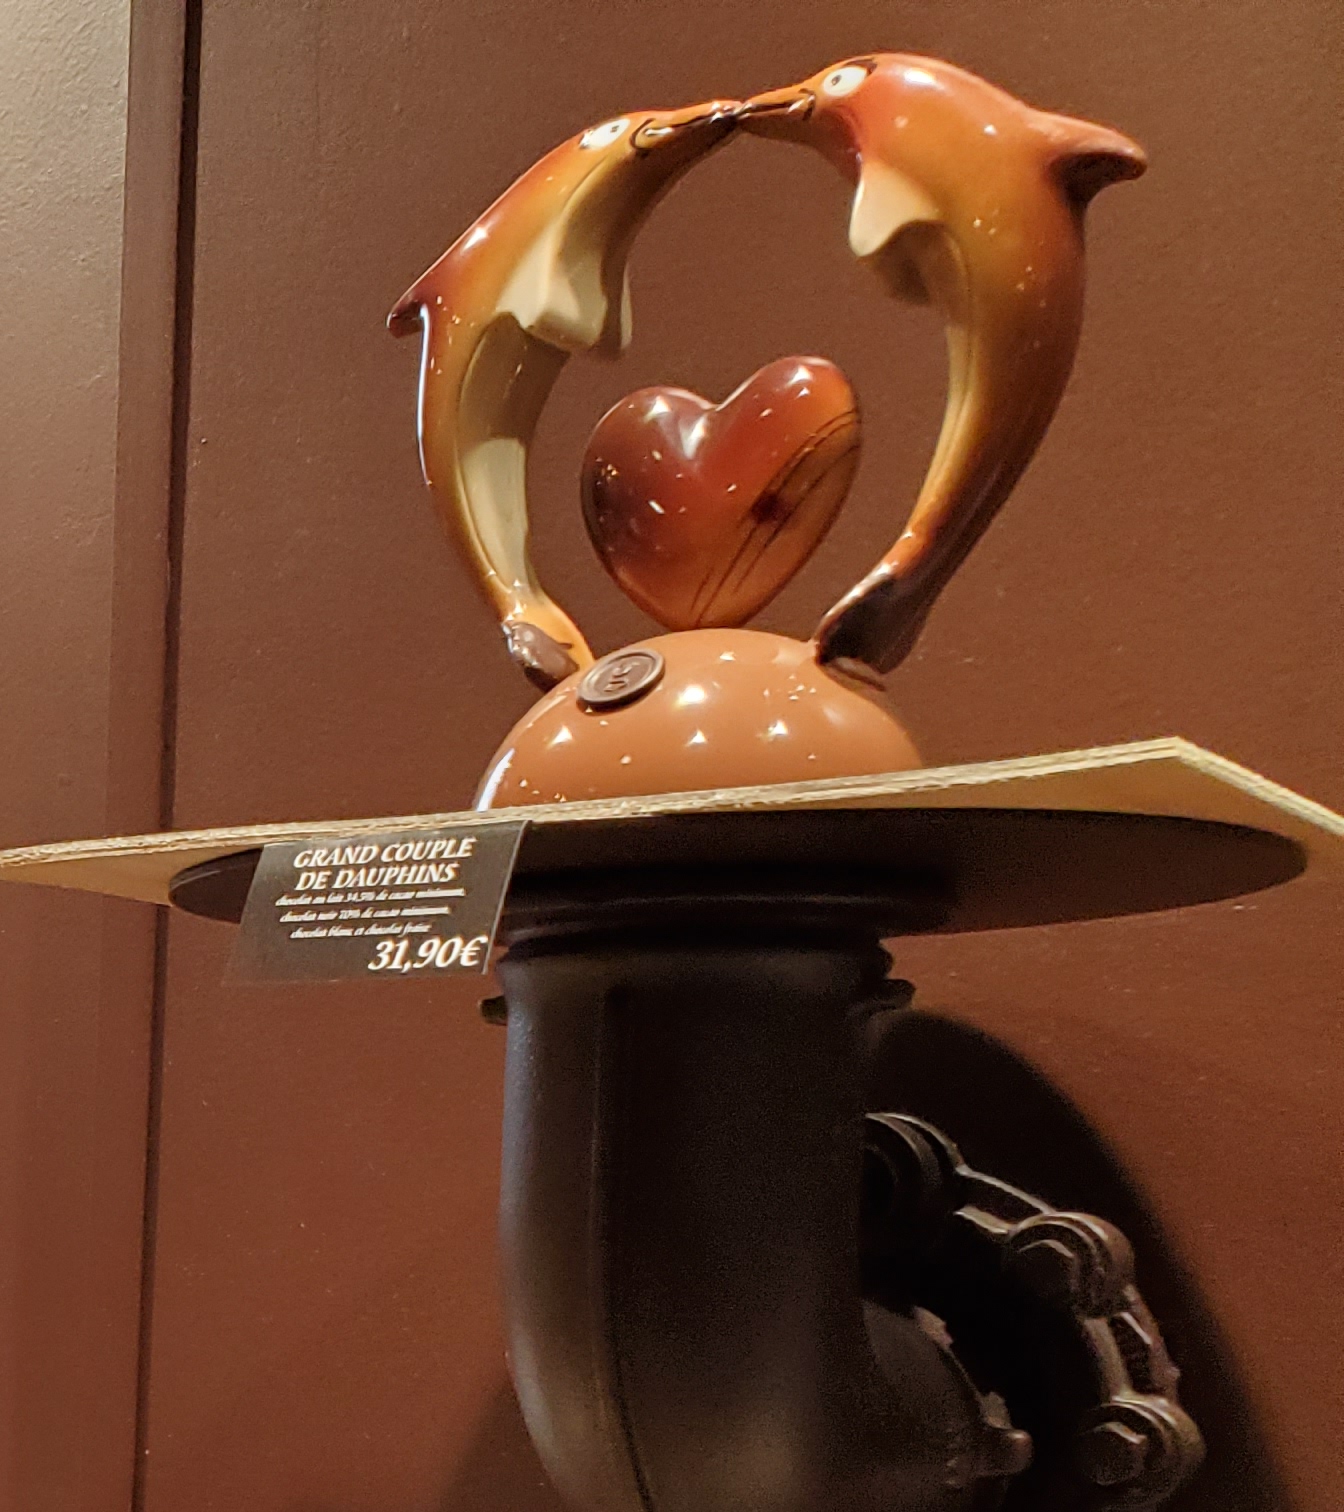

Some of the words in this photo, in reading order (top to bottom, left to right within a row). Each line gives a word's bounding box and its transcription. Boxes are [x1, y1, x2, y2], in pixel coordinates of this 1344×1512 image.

[293, 845, 378, 868] GRAND
[380, 837, 477, 861] COUPLE
[294, 871, 329, 890] DE
[332, 862, 460, 889] DAUPHINS
[368, 934, 489, 974] 31,90€
